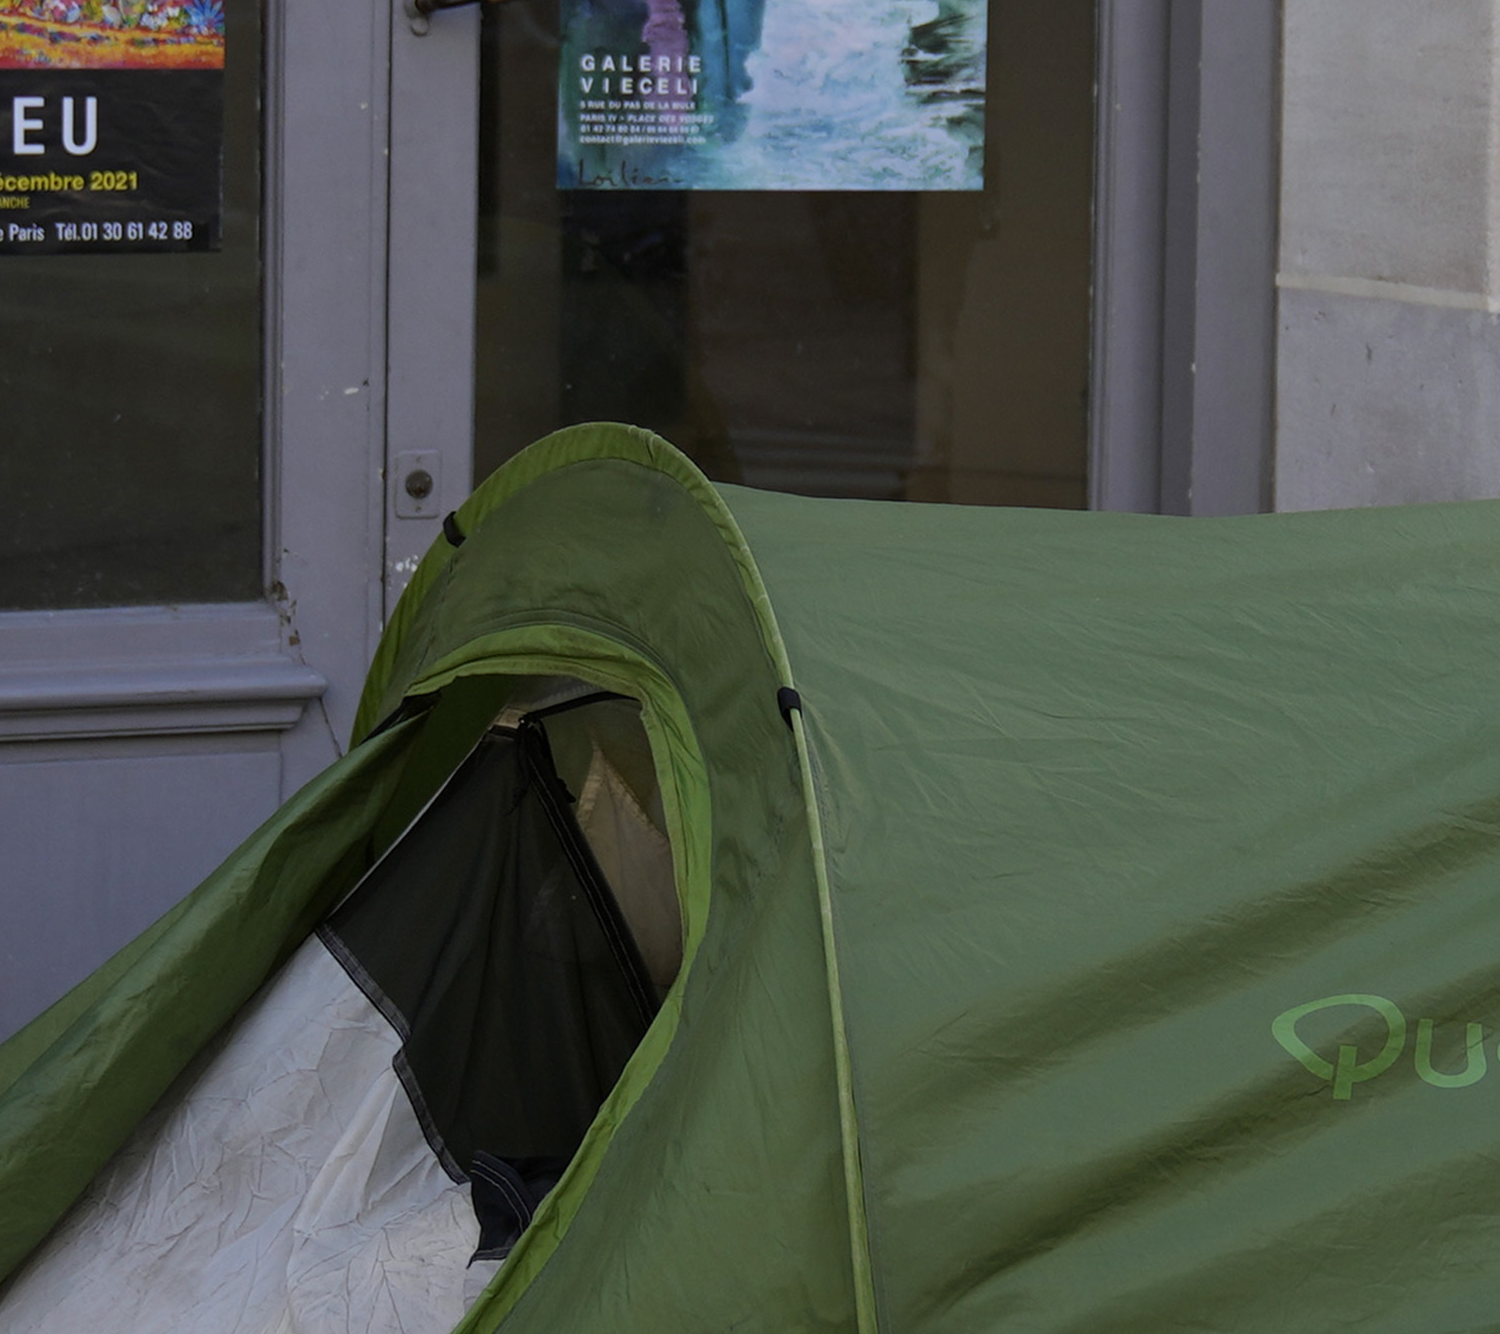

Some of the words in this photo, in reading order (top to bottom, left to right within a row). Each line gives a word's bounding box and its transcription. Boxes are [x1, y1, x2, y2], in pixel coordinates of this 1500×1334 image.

[581, 55, 701, 72] GALERIE
[580, 77, 698, 94] VIECELI
[608, 101, 621, 110] DU
[623, 101, 640, 110] PAS
[658, 101, 670, 110] LA
[580, 114, 605, 123] PARIS
[627, 114, 656, 123] PLACE
[90, 170, 138, 191] 2021
[9, 223, 45, 243] Paris
[103, 222, 122, 241] 30
[127, 222, 144, 240] 61
[149, 221, 168, 240] 42
[173, 221, 193, 240] 88
